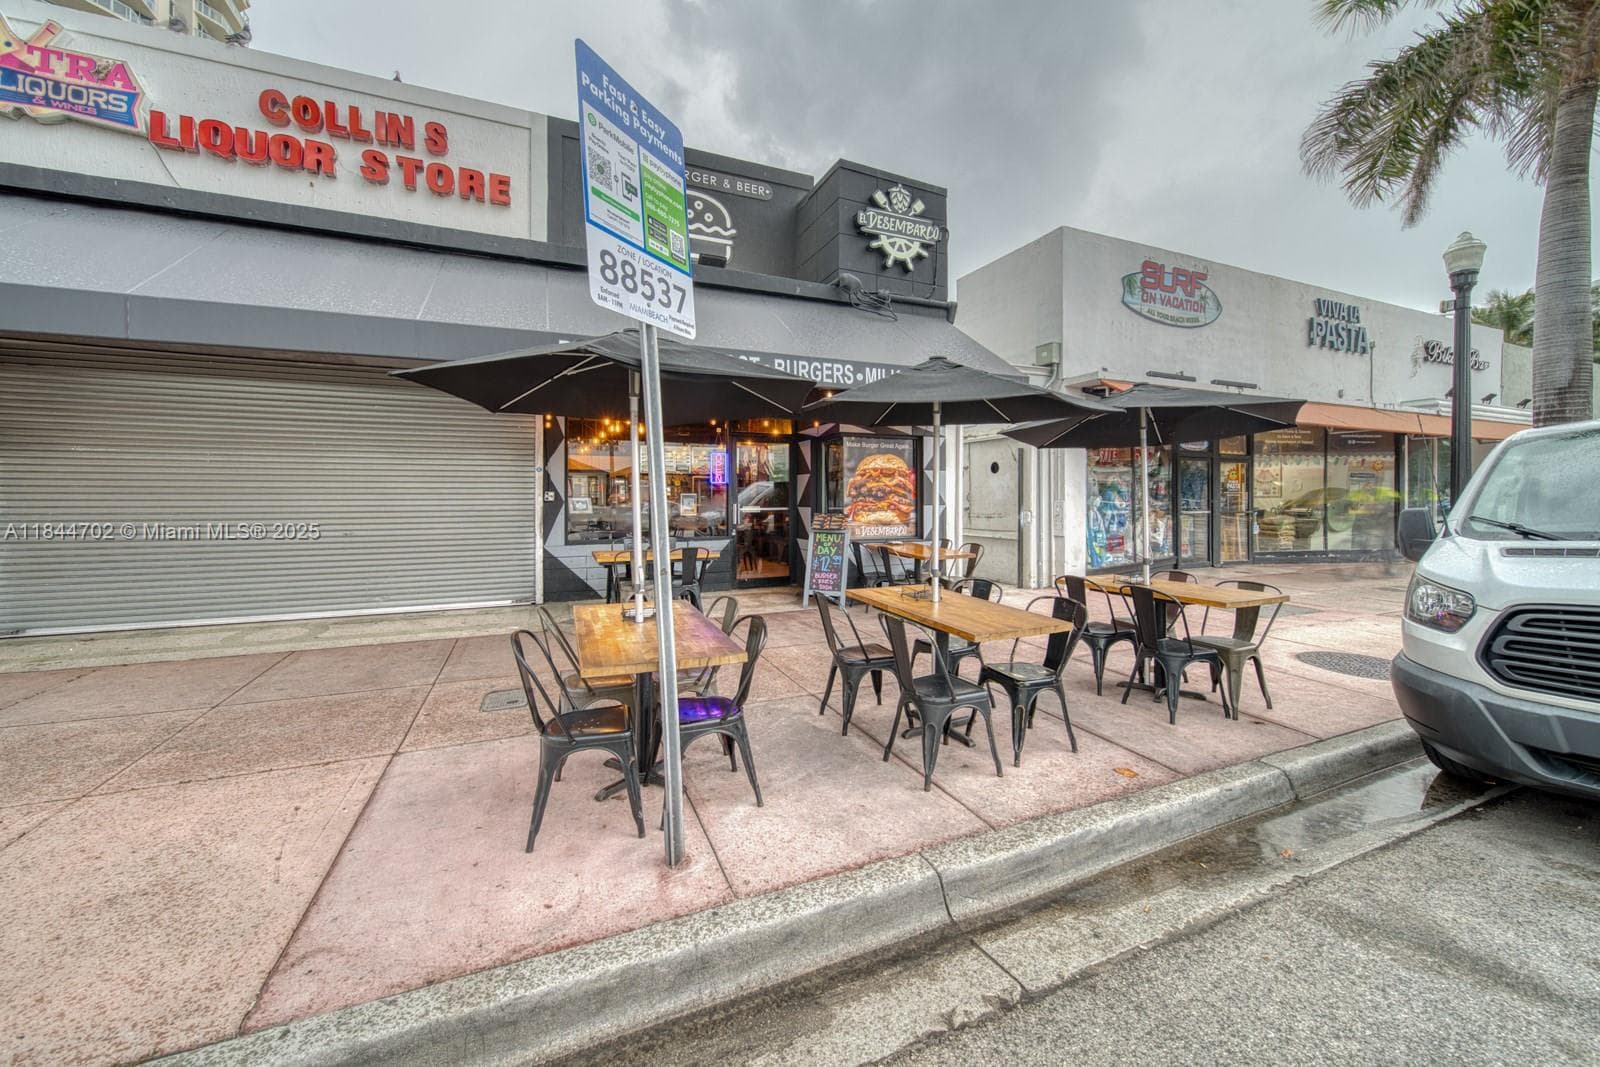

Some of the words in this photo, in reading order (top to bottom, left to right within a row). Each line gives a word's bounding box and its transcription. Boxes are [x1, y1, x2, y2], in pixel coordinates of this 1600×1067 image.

[0, 71, 128, 113] LIQUORS
[32, 96, 46, 106] &
[50, 100, 97, 116] WINES
[602, 74, 627, 105] Fast
[641, 109, 666, 140] Easy
[581, 71, 630, 127] Parking
[633, 117, 683, 166] Payments
[148, 109, 336, 177] LIQUOR
[359, 149, 512, 208] STORE
[684, 169, 717, 186] RGER
[722, 179, 731, 189] &
[736, 181, 765, 196] BEER
[859, 212, 867, 226] EL
[867, 211, 940, 241] DESEMBARCO
[616, 244, 637, 262] ZONE
[642, 256, 673, 279] LOCATION
[599, 249, 687, 314] 88537
[1140, 259, 1208, 297] SURF
[1141, 291, 1157, 305] ON
[1160, 293, 1206, 314] VACATION
[1314, 298, 1347, 321] VIVA
[1348, 305, 1360, 323] LA
[1308, 317, 1369, 354] PASTA
[774, 358, 854, 385] BURGERS
[816, 533, 841, 543] MENU
[817, 546, 837, 557] DAY
